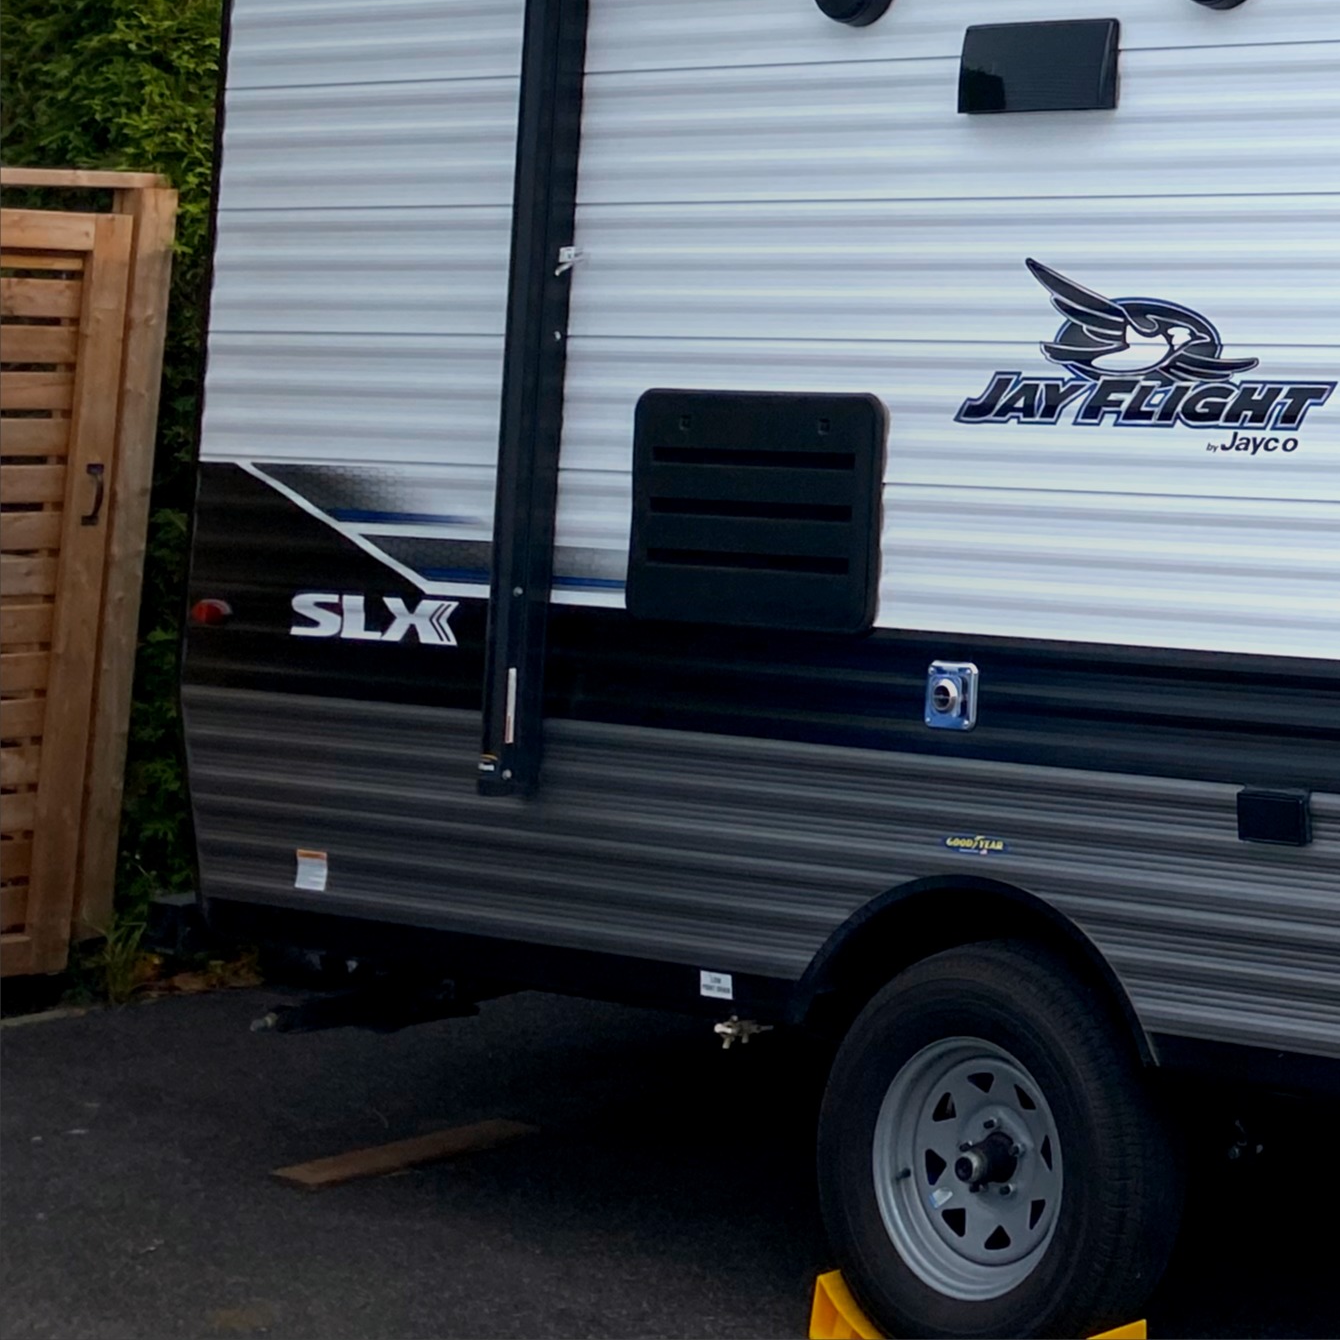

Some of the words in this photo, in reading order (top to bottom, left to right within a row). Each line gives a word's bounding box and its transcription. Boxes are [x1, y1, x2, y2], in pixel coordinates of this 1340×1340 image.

[953, 371, 1091, 425] JAY
[1072, 374, 1339, 431] FLIGHT
[1205, 442, 1219, 453] by
[1220, 432, 1299, 456] Jayco
[289, 592, 460, 647] SLX
